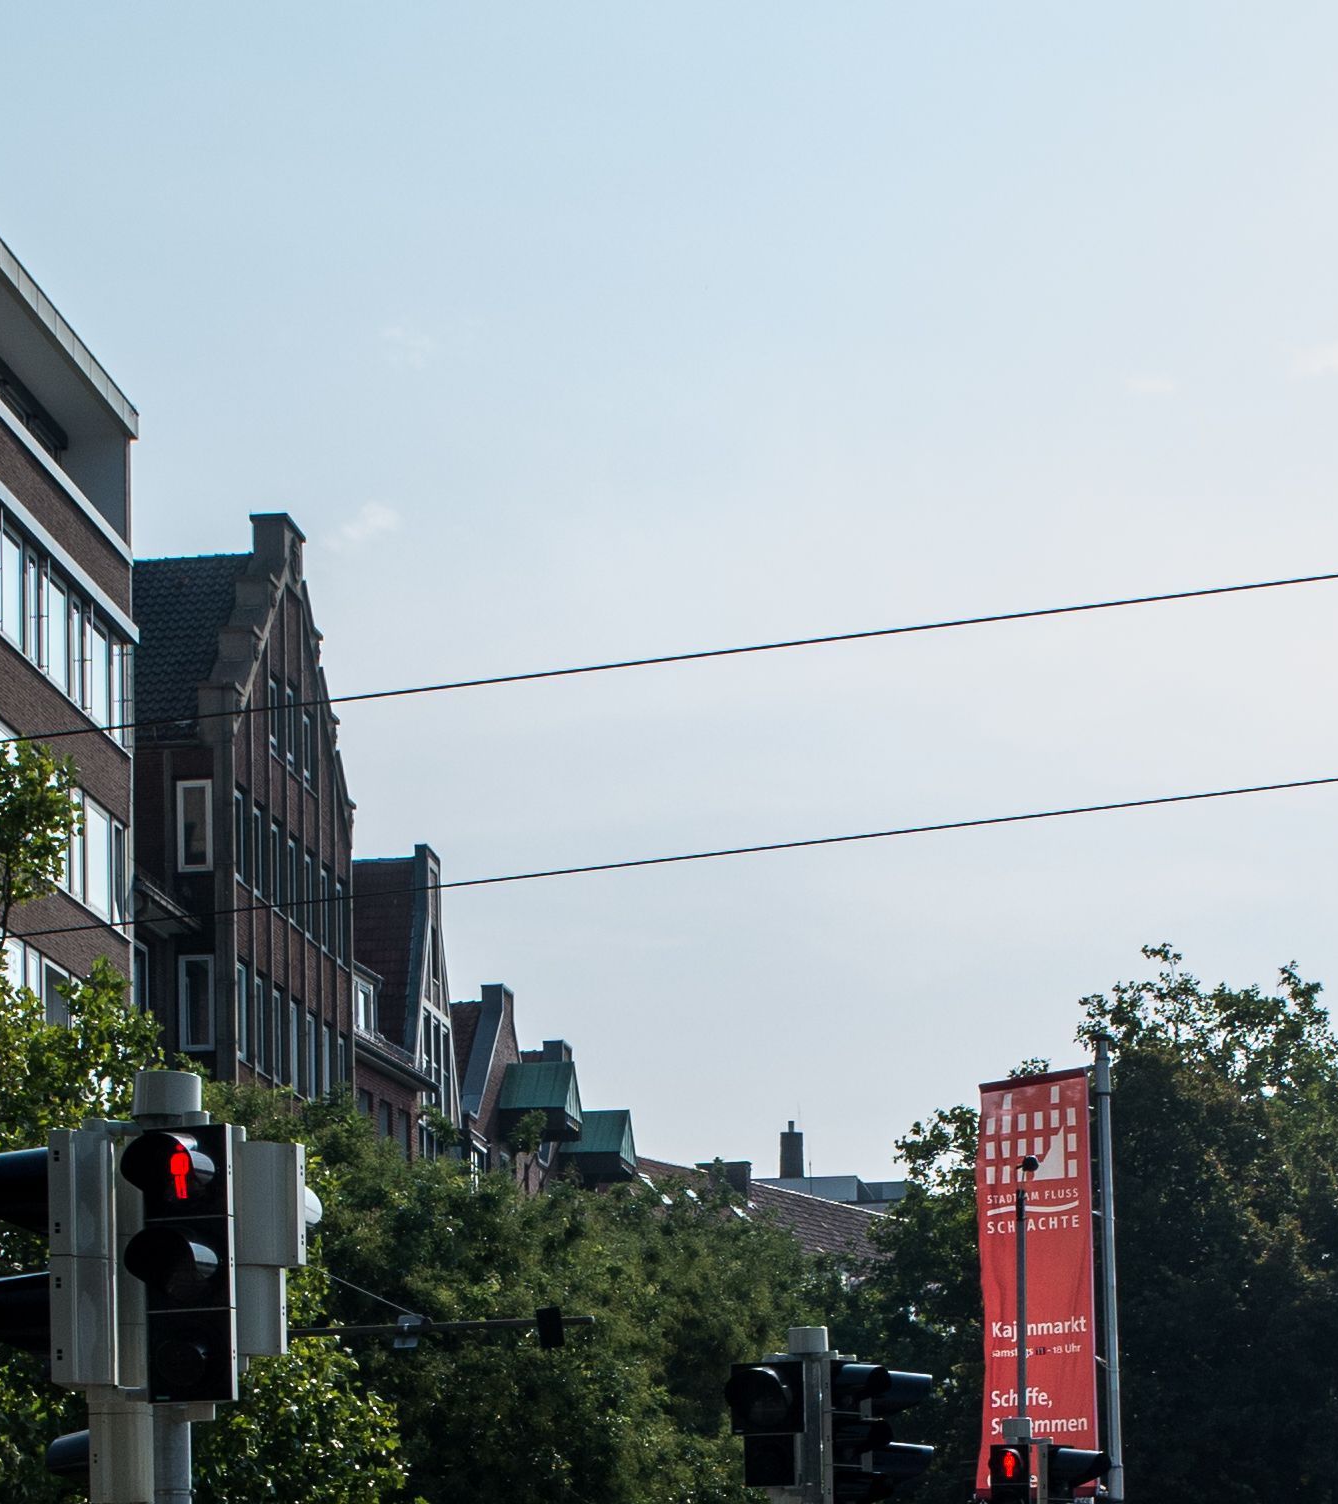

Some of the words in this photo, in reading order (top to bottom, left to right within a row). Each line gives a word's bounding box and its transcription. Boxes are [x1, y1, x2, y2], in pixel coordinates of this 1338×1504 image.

[1044, 1188, 1079, 1200] FLUSS
[987, 1215, 1080, 1234] SCHACHTE
[991, 1316, 1087, 1342] Kajnmarkt
[991, 1347, 1033, 1359] samstgs
[1065, 1343, 1081, 1354] Uhr
[991, 1387, 1053, 1408] Schffe,
[991, 1417, 1088, 1435] Smmen
